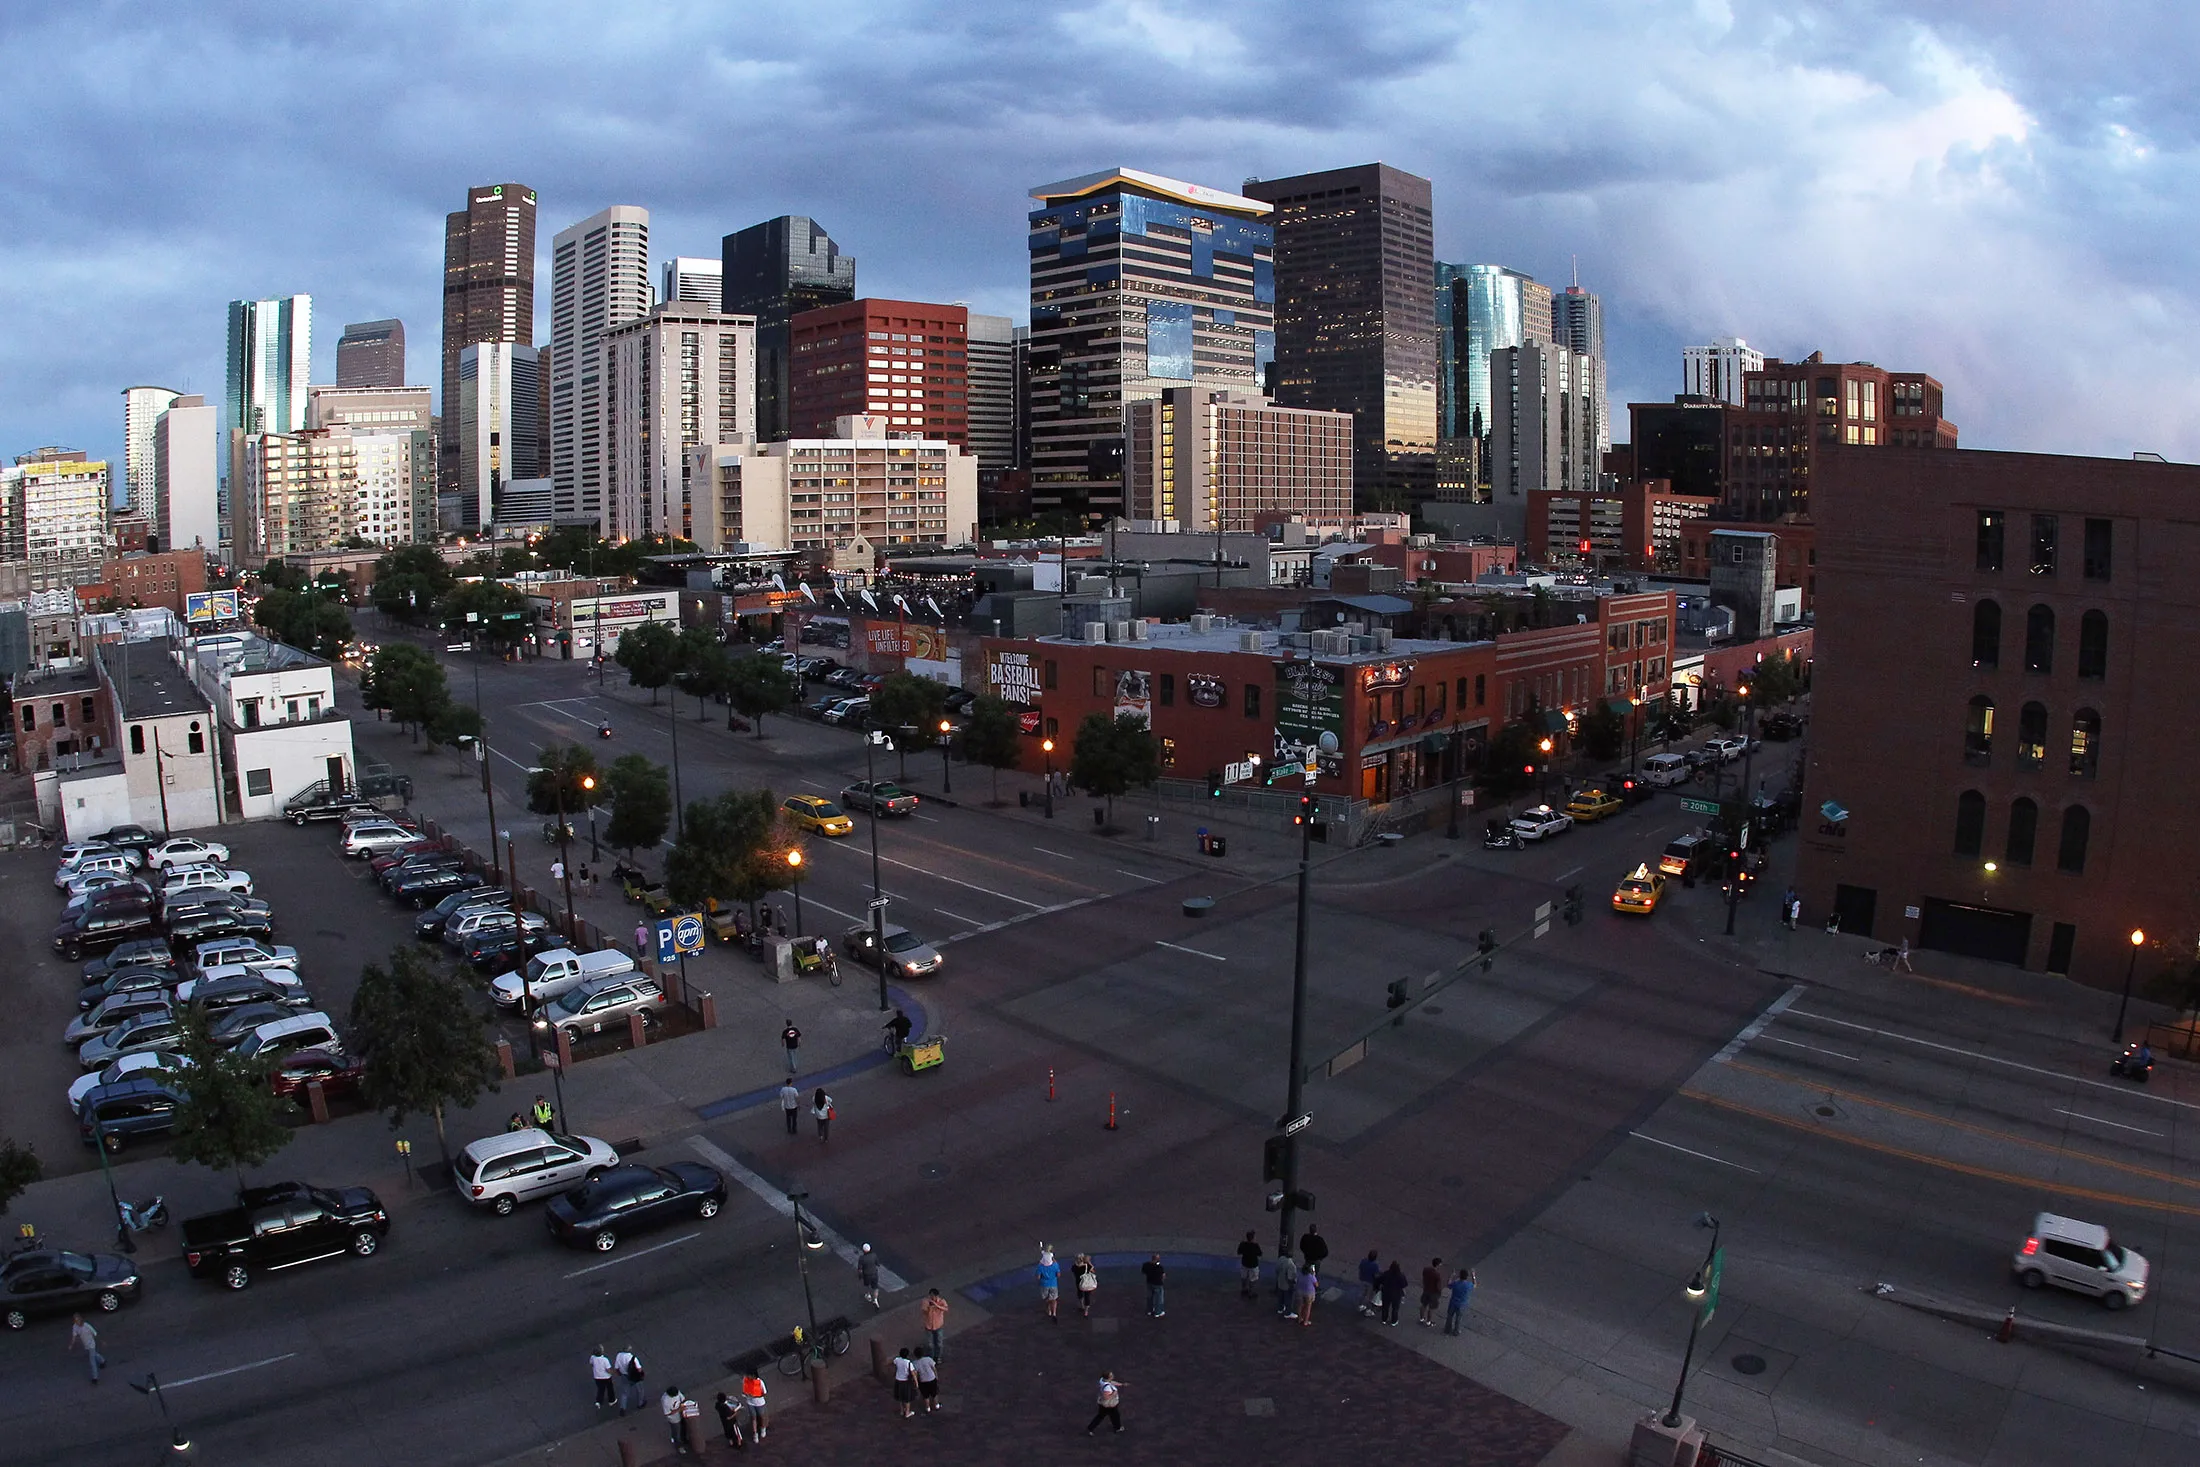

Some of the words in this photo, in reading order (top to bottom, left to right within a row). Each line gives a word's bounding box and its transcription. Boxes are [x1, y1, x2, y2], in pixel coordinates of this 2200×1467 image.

[868, 629, 880, 641] LIVE
[881, 629, 895, 641] LIFE
[1000, 652, 1029, 666] WELCOME
[991, 663, 1041, 690] BASEBALL
[1001, 684, 1030, 706] FANS!
[1276, 766, 1289, 777] Blake
[1690, 802, 1708, 811] 20th
[659, 929, 672, 949] P
[663, 954, 676, 962] $25
